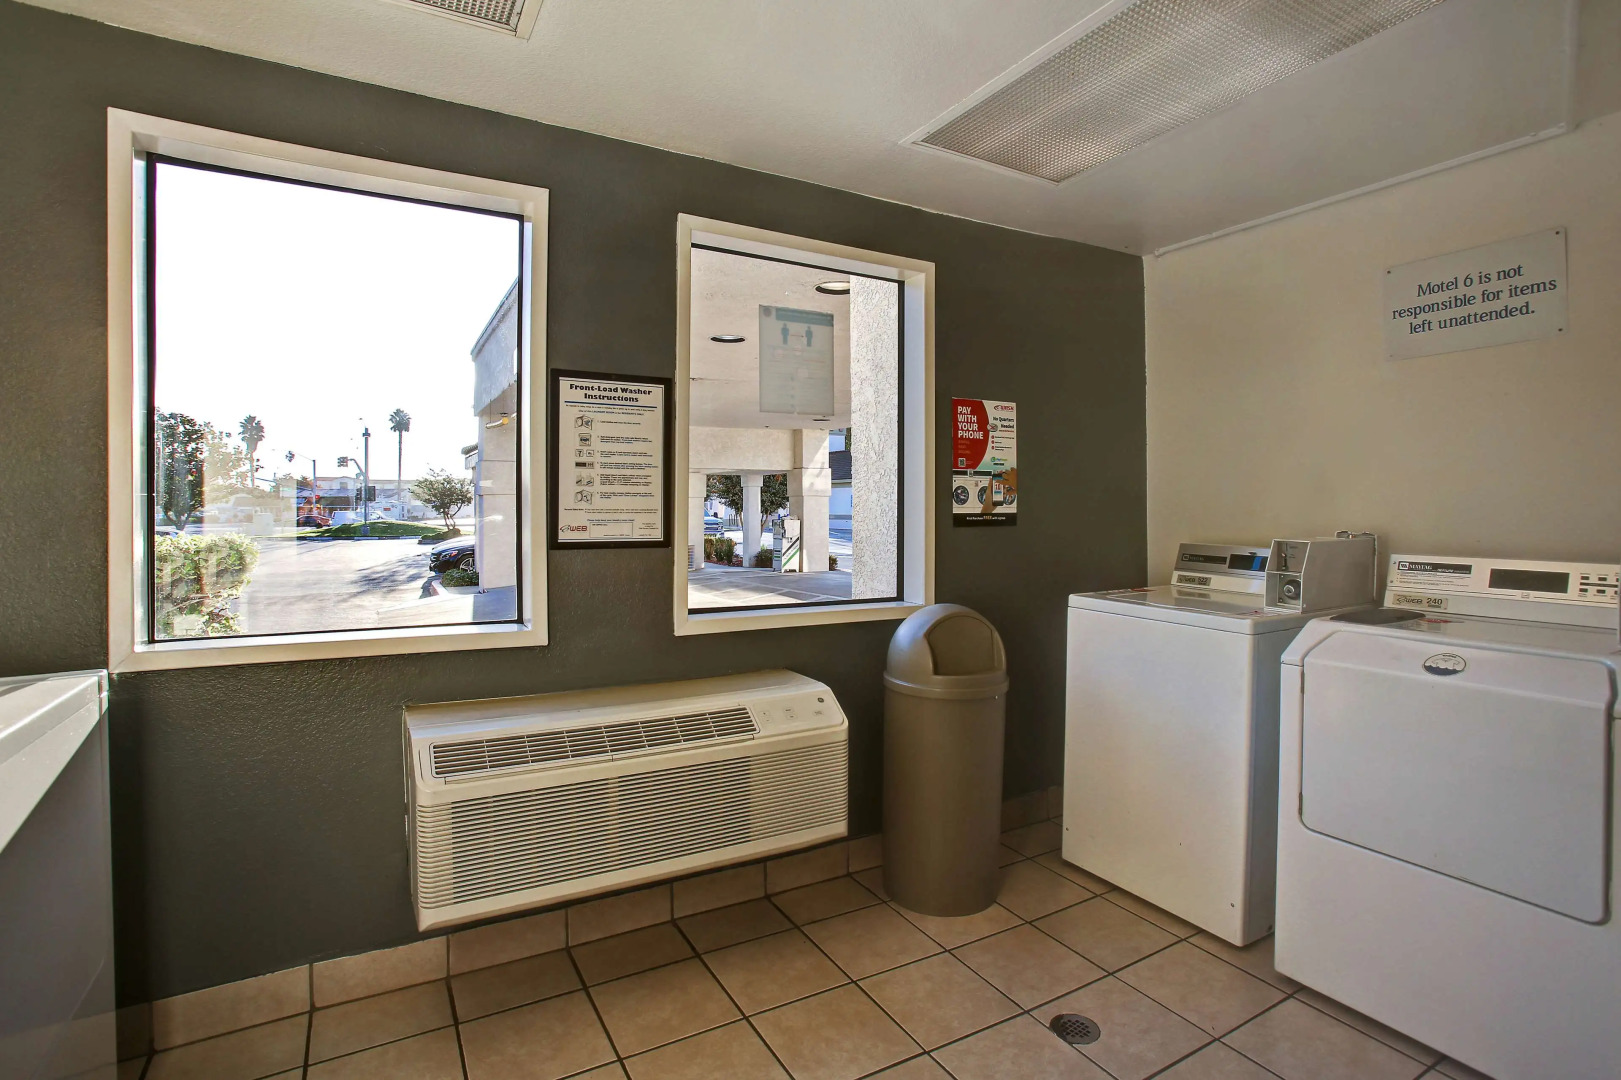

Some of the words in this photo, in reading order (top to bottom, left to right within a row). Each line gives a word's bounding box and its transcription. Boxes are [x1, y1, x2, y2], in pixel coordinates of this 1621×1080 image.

[1416, 276, 1458, 297] Motel
[1463, 273, 1474, 288] 6
[1478, 271, 1491, 285] is
[1496, 264, 1524, 281] not
[1392, 293, 1476, 320] responsible
[1480, 289, 1503, 304] for
[1508, 279, 1557, 298] items
[1409, 320, 1434, 334] left
[1437, 301, 1535, 330] unattended.
[569, 384, 618, 393] Front-Load
[620, 387, 652, 395] Washer
[584, 393, 639, 402] Instructions
[957, 406, 971, 414] PAY
[957, 414, 977, 422] WITH
[957, 422, 978, 431] YOUR
[958, 430, 984, 439] PHONE
